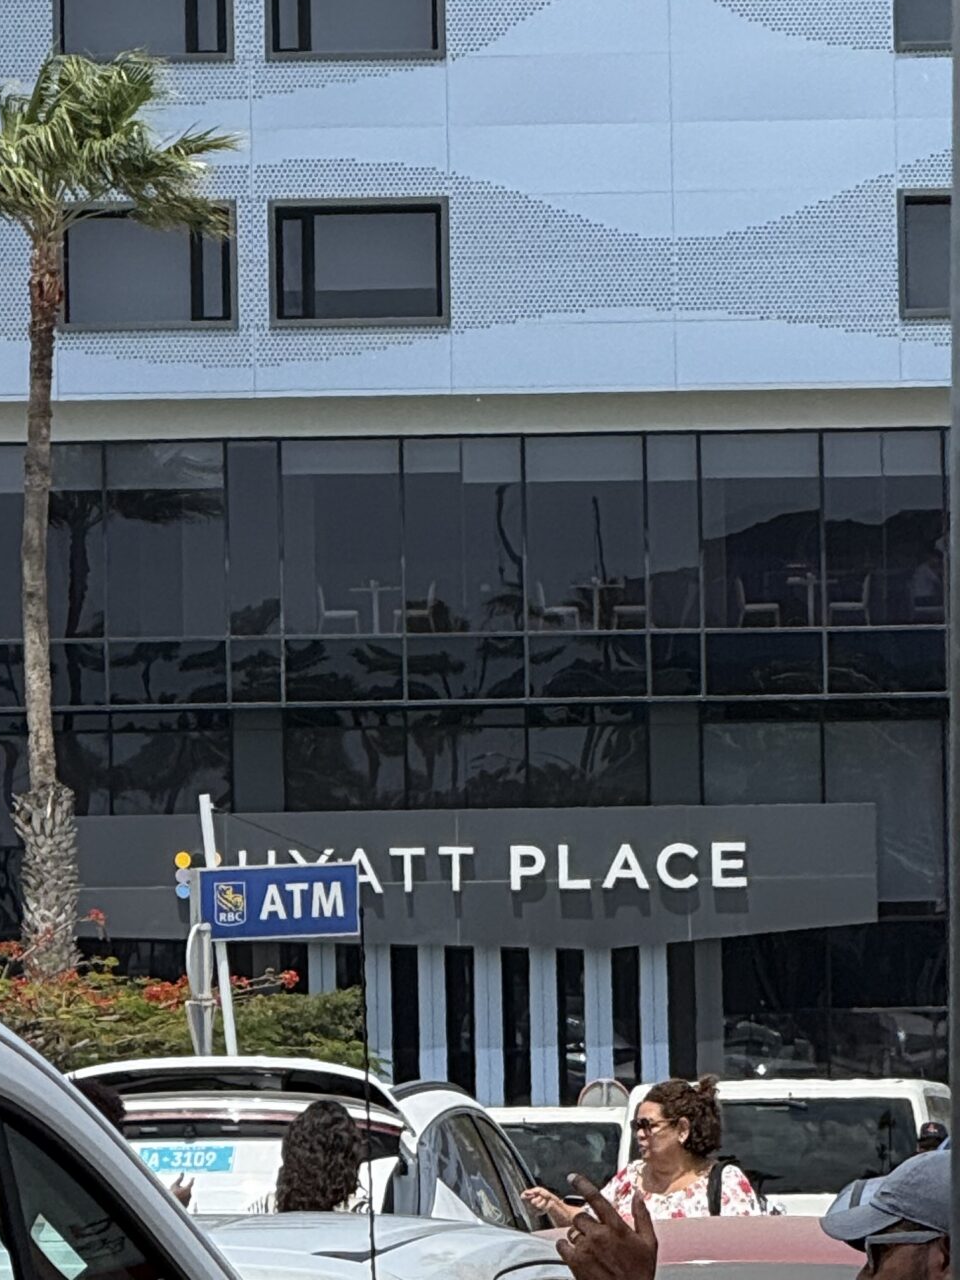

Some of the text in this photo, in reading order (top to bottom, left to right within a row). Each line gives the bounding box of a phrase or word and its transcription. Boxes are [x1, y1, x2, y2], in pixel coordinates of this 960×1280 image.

[510, 841, 748, 891] PLACE
[219, 911, 243, 922] RBC
[259, 881, 345, 920] ATM
